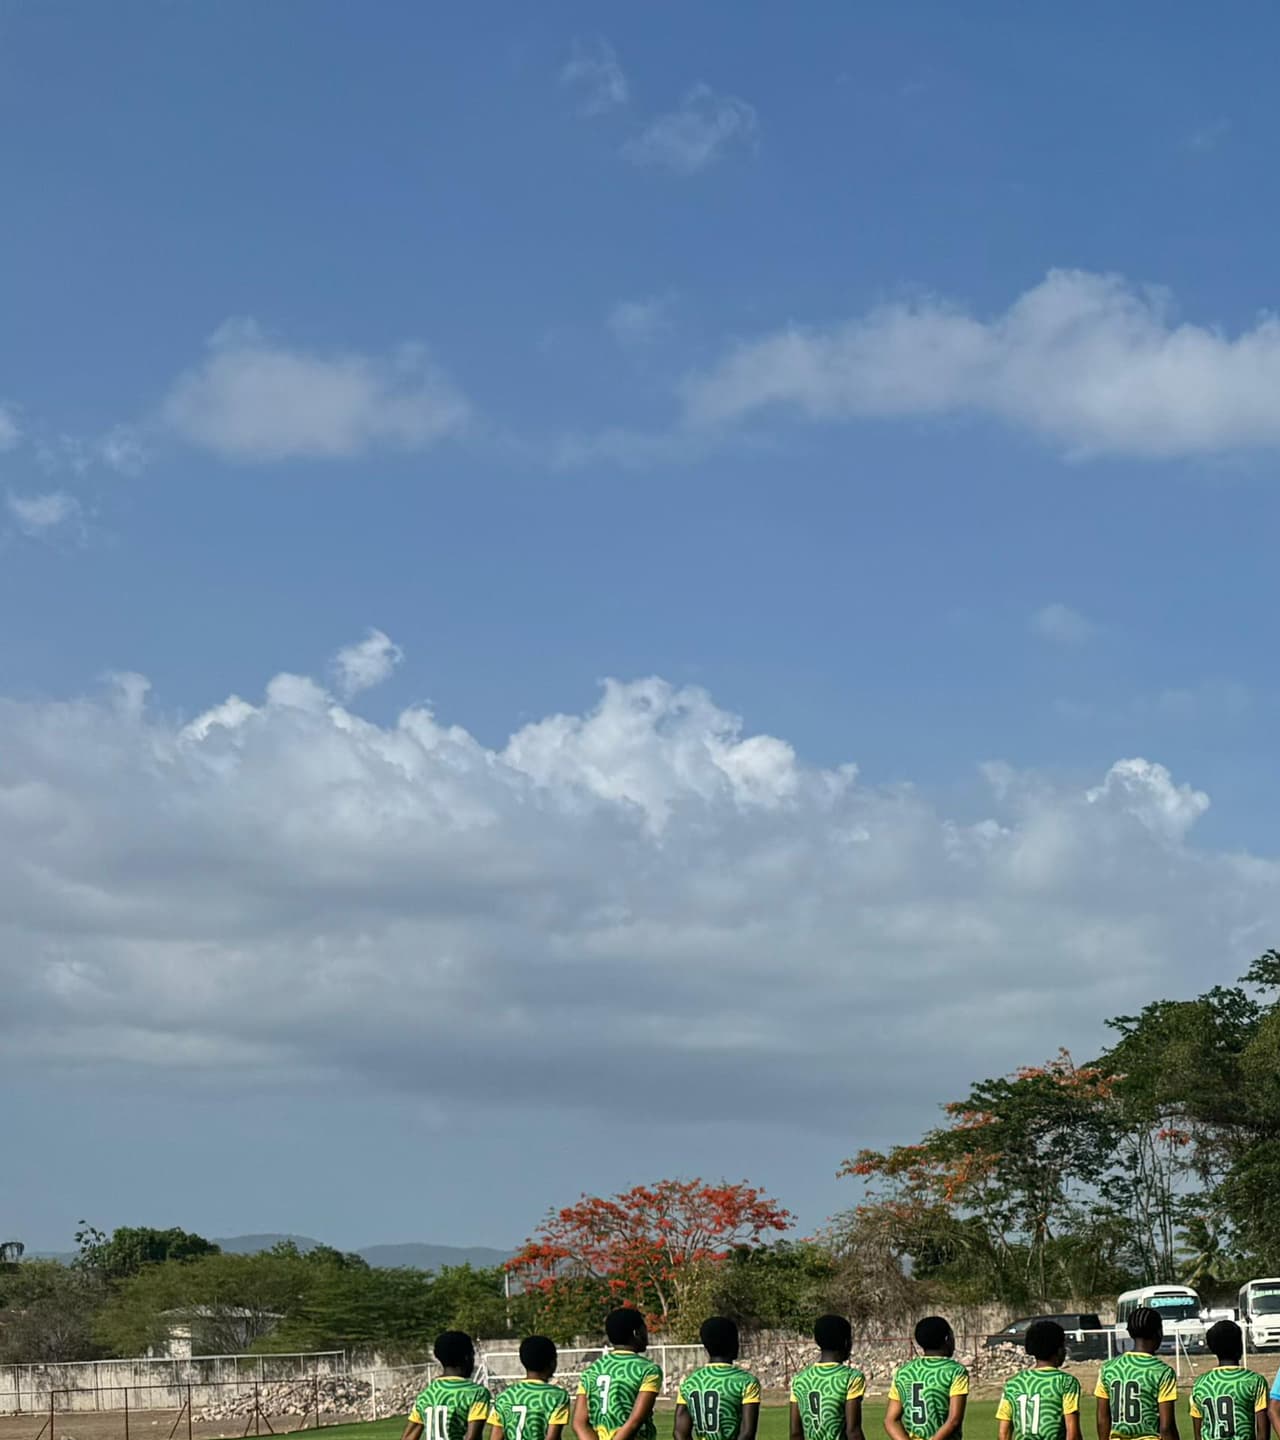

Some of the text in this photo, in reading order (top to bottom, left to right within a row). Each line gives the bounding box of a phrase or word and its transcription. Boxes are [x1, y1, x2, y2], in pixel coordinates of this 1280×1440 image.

[688, 1390, 720, 1433] 18
[808, 1390, 822, 1431] 9
[912, 1382, 927, 1426] 5
[1017, 1393, 1040, 1435] 11
[1110, 1379, 1142, 1425] 16
[1202, 1395, 1236, 1440] 19
